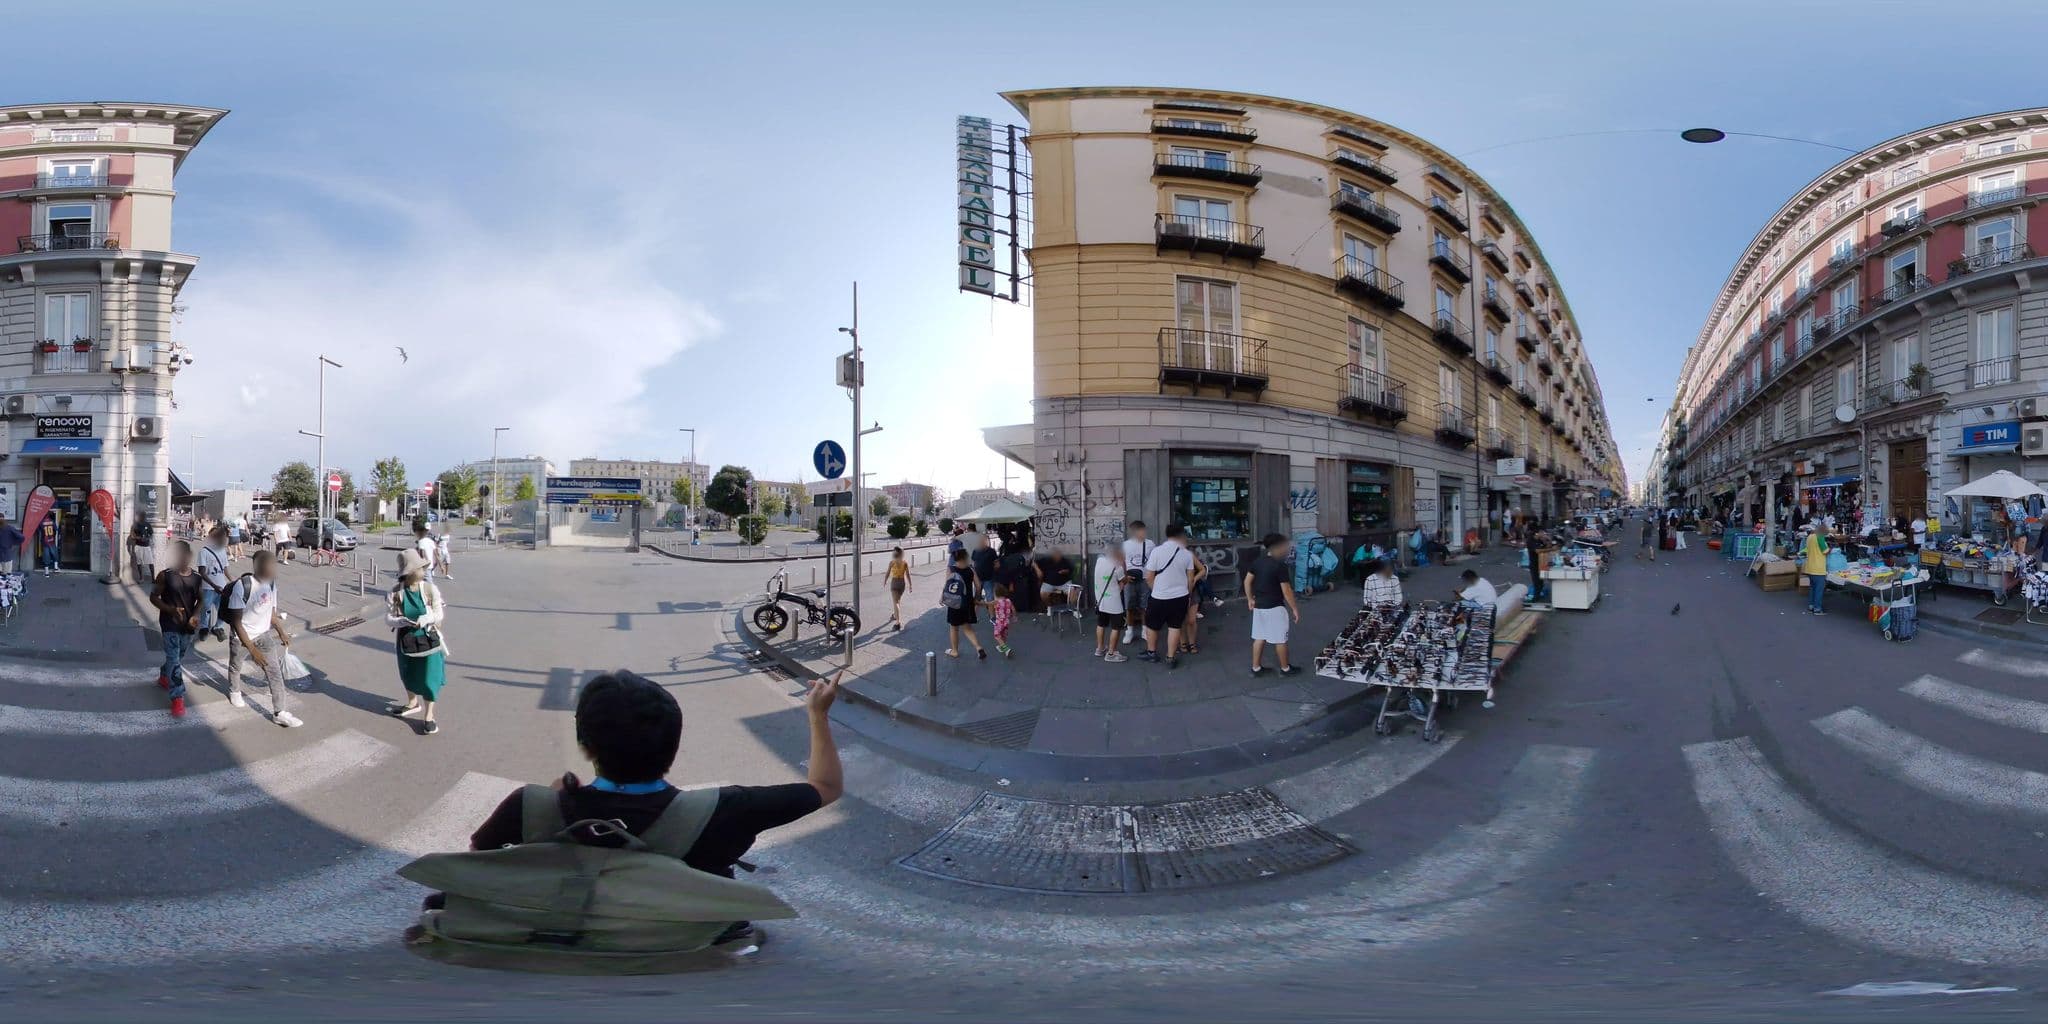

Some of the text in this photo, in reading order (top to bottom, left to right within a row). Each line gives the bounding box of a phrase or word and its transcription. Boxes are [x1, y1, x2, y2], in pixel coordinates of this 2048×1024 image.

[38, 417, 91, 426] renoovo
[1985, 428, 2008, 441] TIM
[556, 479, 601, 488] Parcheggio
[43, 525, 53, 536] 10
